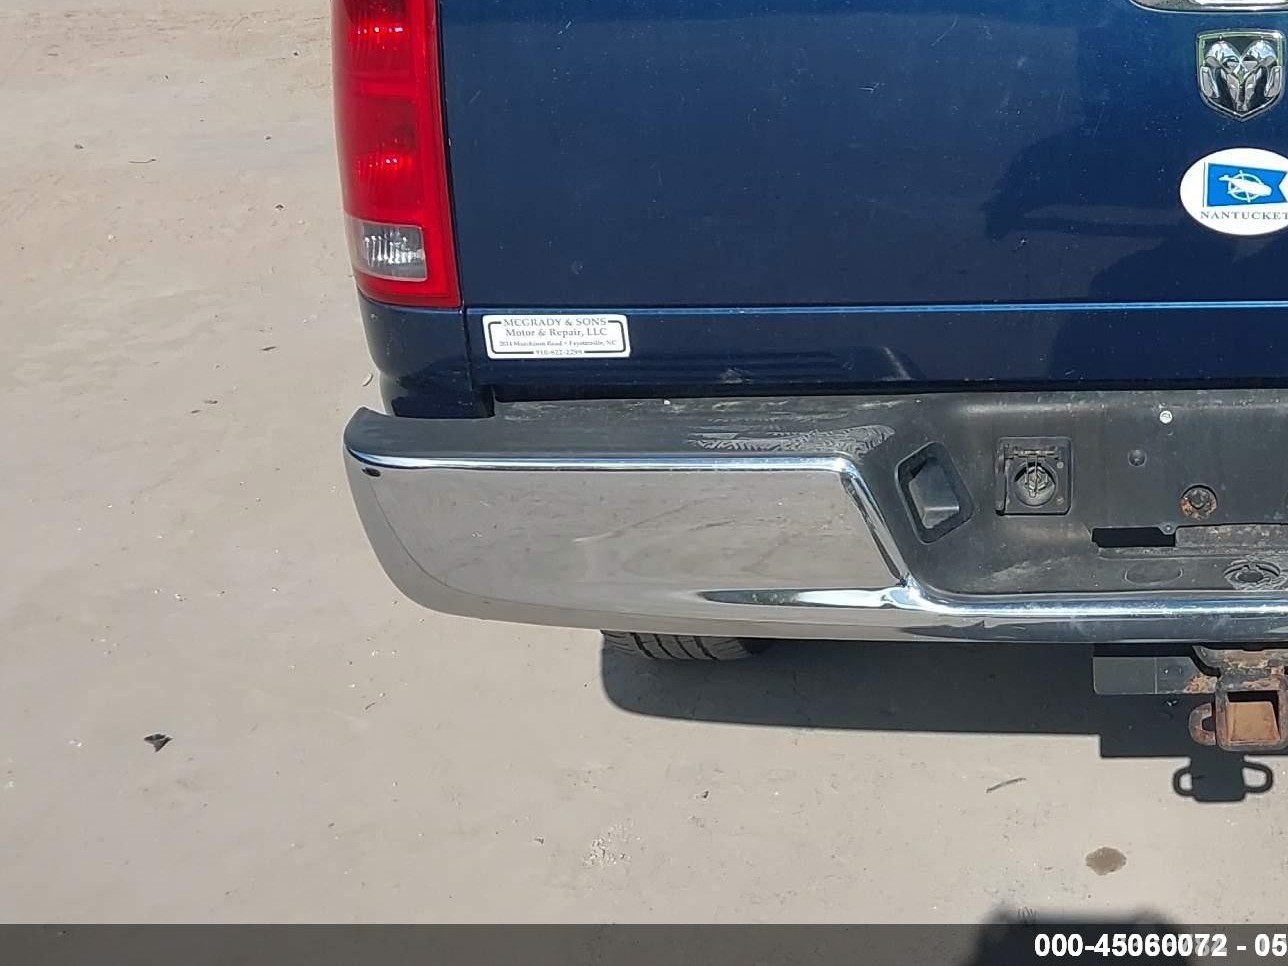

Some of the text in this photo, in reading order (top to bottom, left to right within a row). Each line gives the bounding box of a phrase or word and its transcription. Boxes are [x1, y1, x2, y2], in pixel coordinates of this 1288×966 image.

[564, 318, 574, 326] &
[576, 317, 607, 326] SONS
[505, 328, 608, 338] Motor & Repair, LLC
